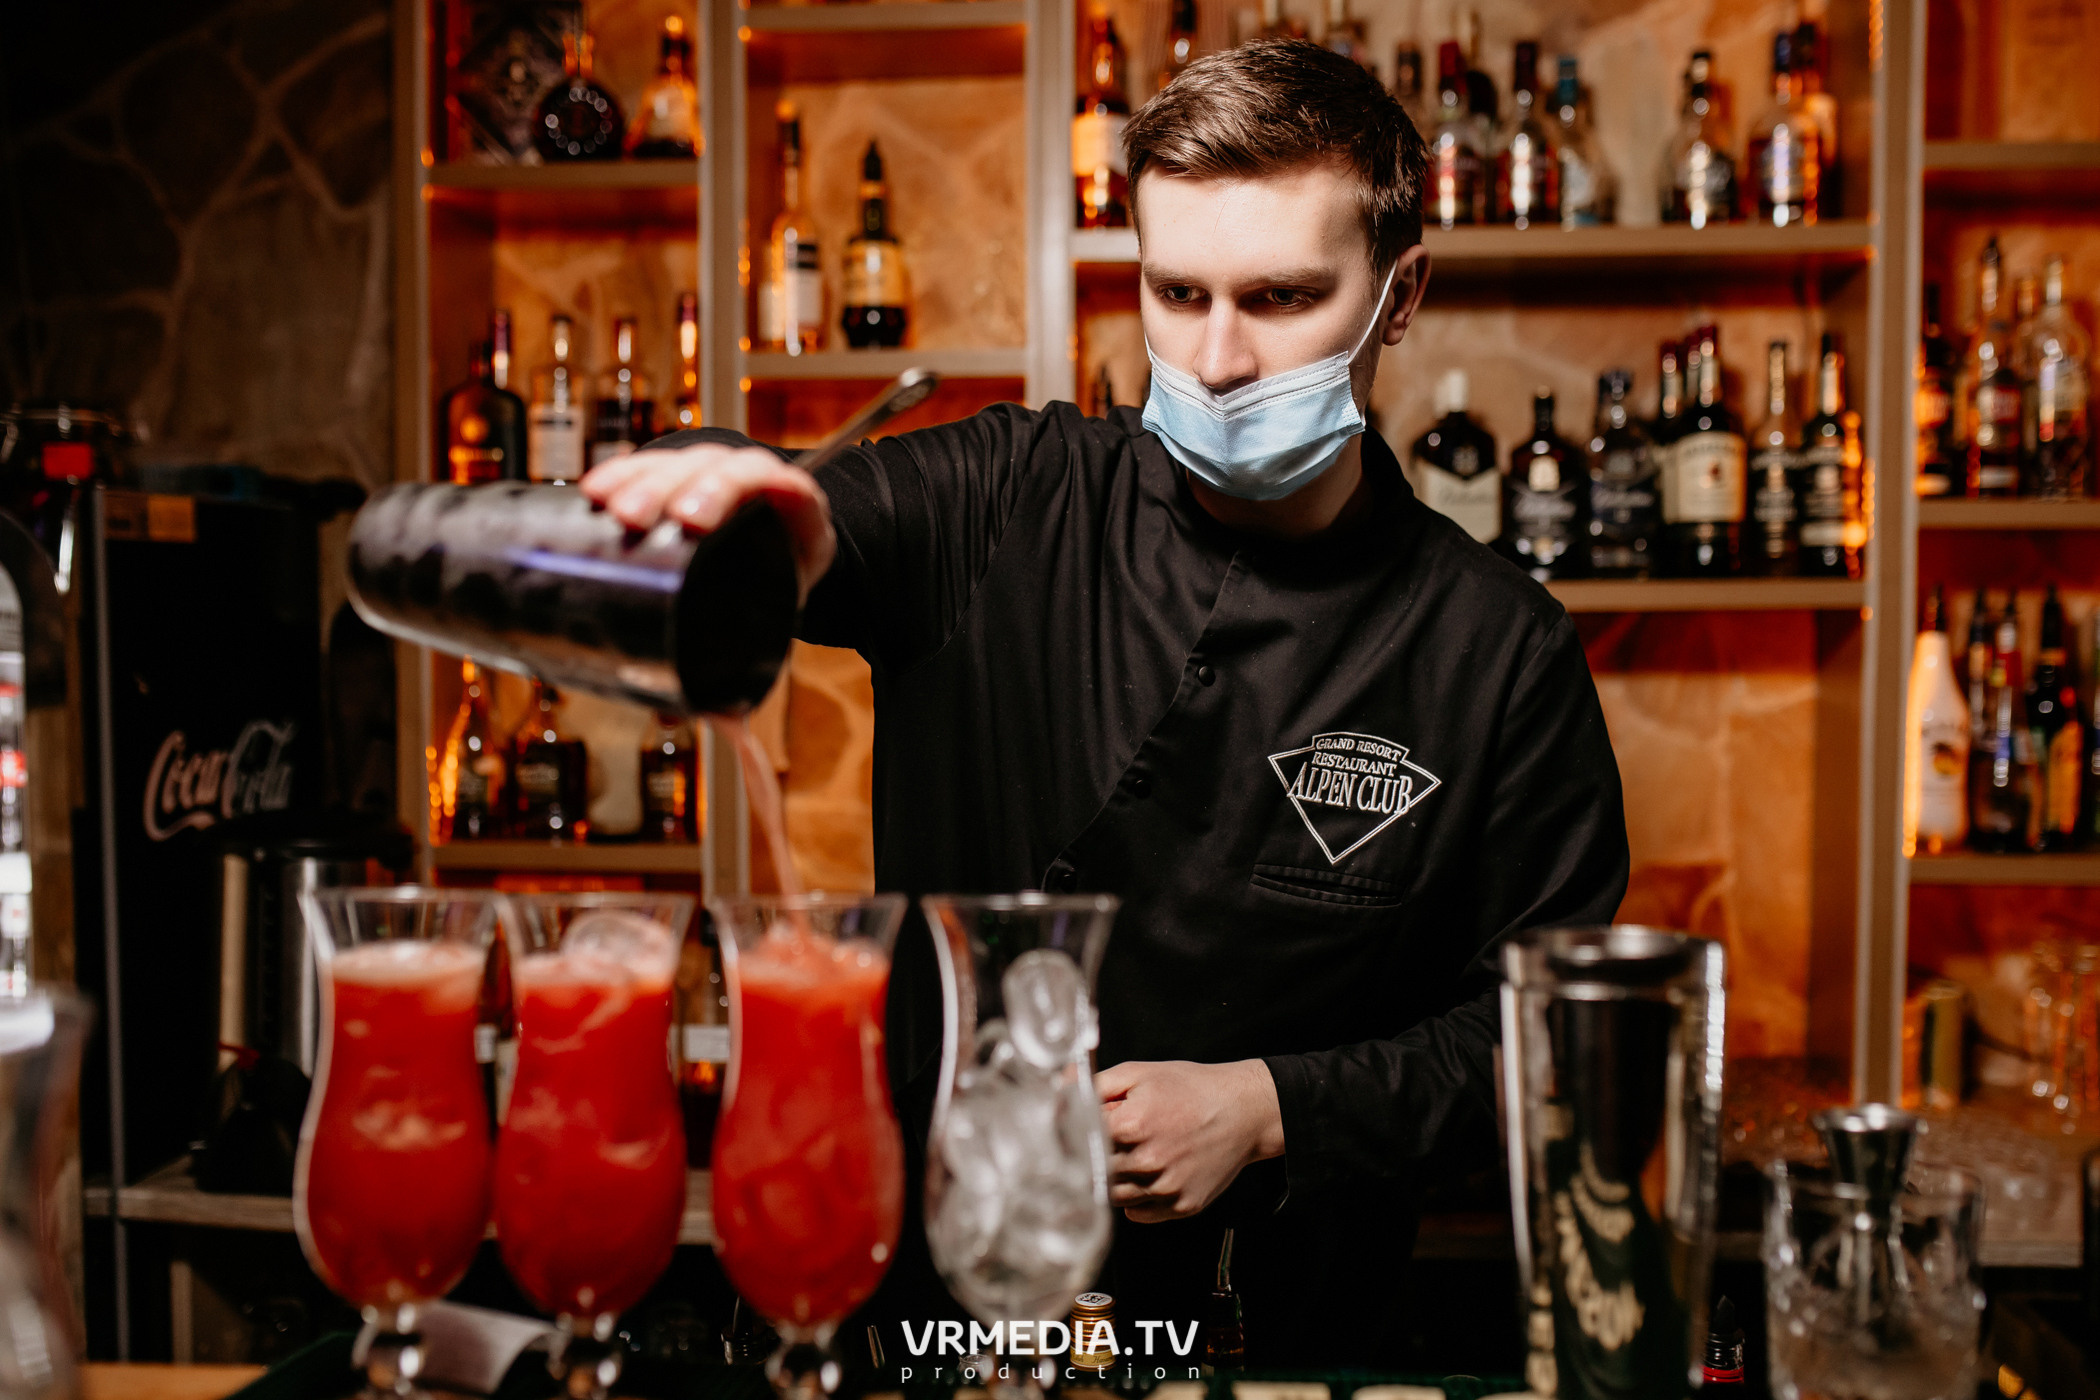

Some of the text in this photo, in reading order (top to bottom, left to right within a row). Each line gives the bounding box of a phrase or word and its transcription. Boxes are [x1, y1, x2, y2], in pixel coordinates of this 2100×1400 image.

[1316, 738, 1402, 762] GRAND RESORT
[1312, 752, 1397, 776] RESTAURANT
[1287, 762, 1413, 815] ALPEN CLUB
